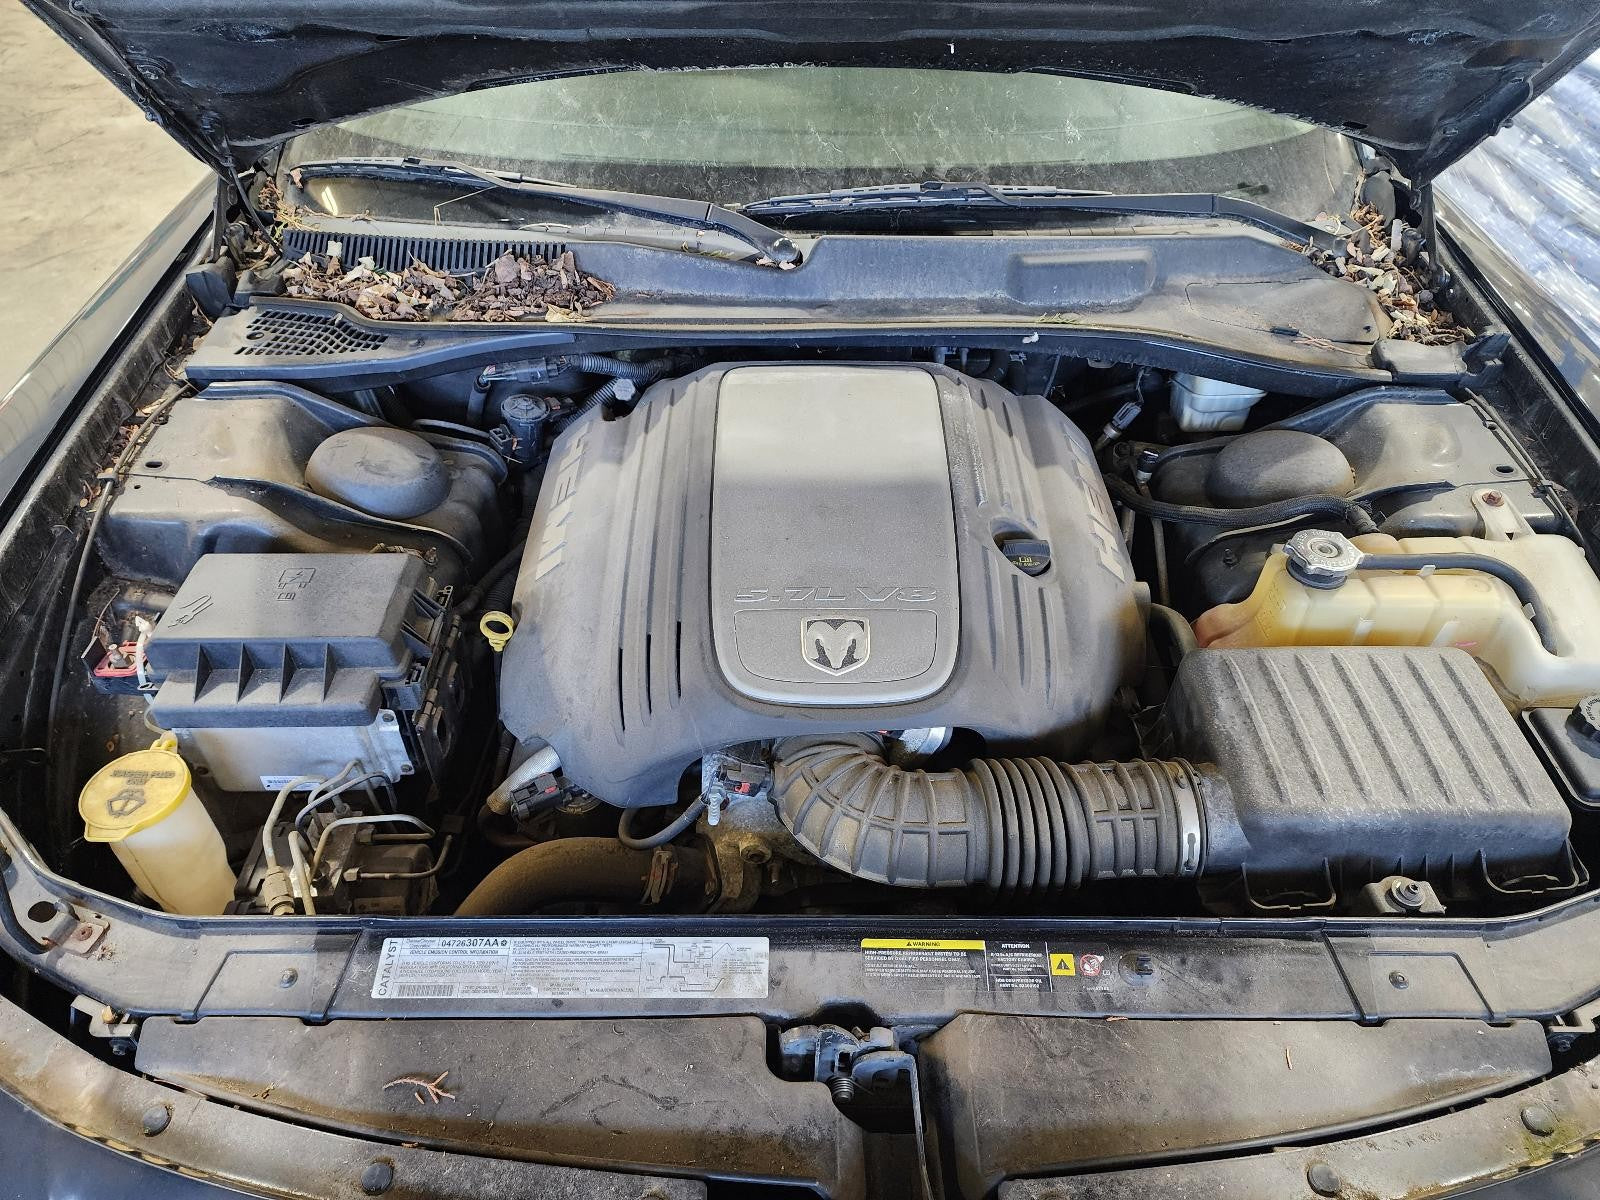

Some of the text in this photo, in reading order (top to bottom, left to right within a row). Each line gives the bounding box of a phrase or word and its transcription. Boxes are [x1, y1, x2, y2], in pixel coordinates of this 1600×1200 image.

[536, 422, 590, 581] HEMI
[734, 586, 937, 602] 5.7L V8
[441, 938, 499, 947] 04726307AA
[378, 939, 398, 996] CATALYST
